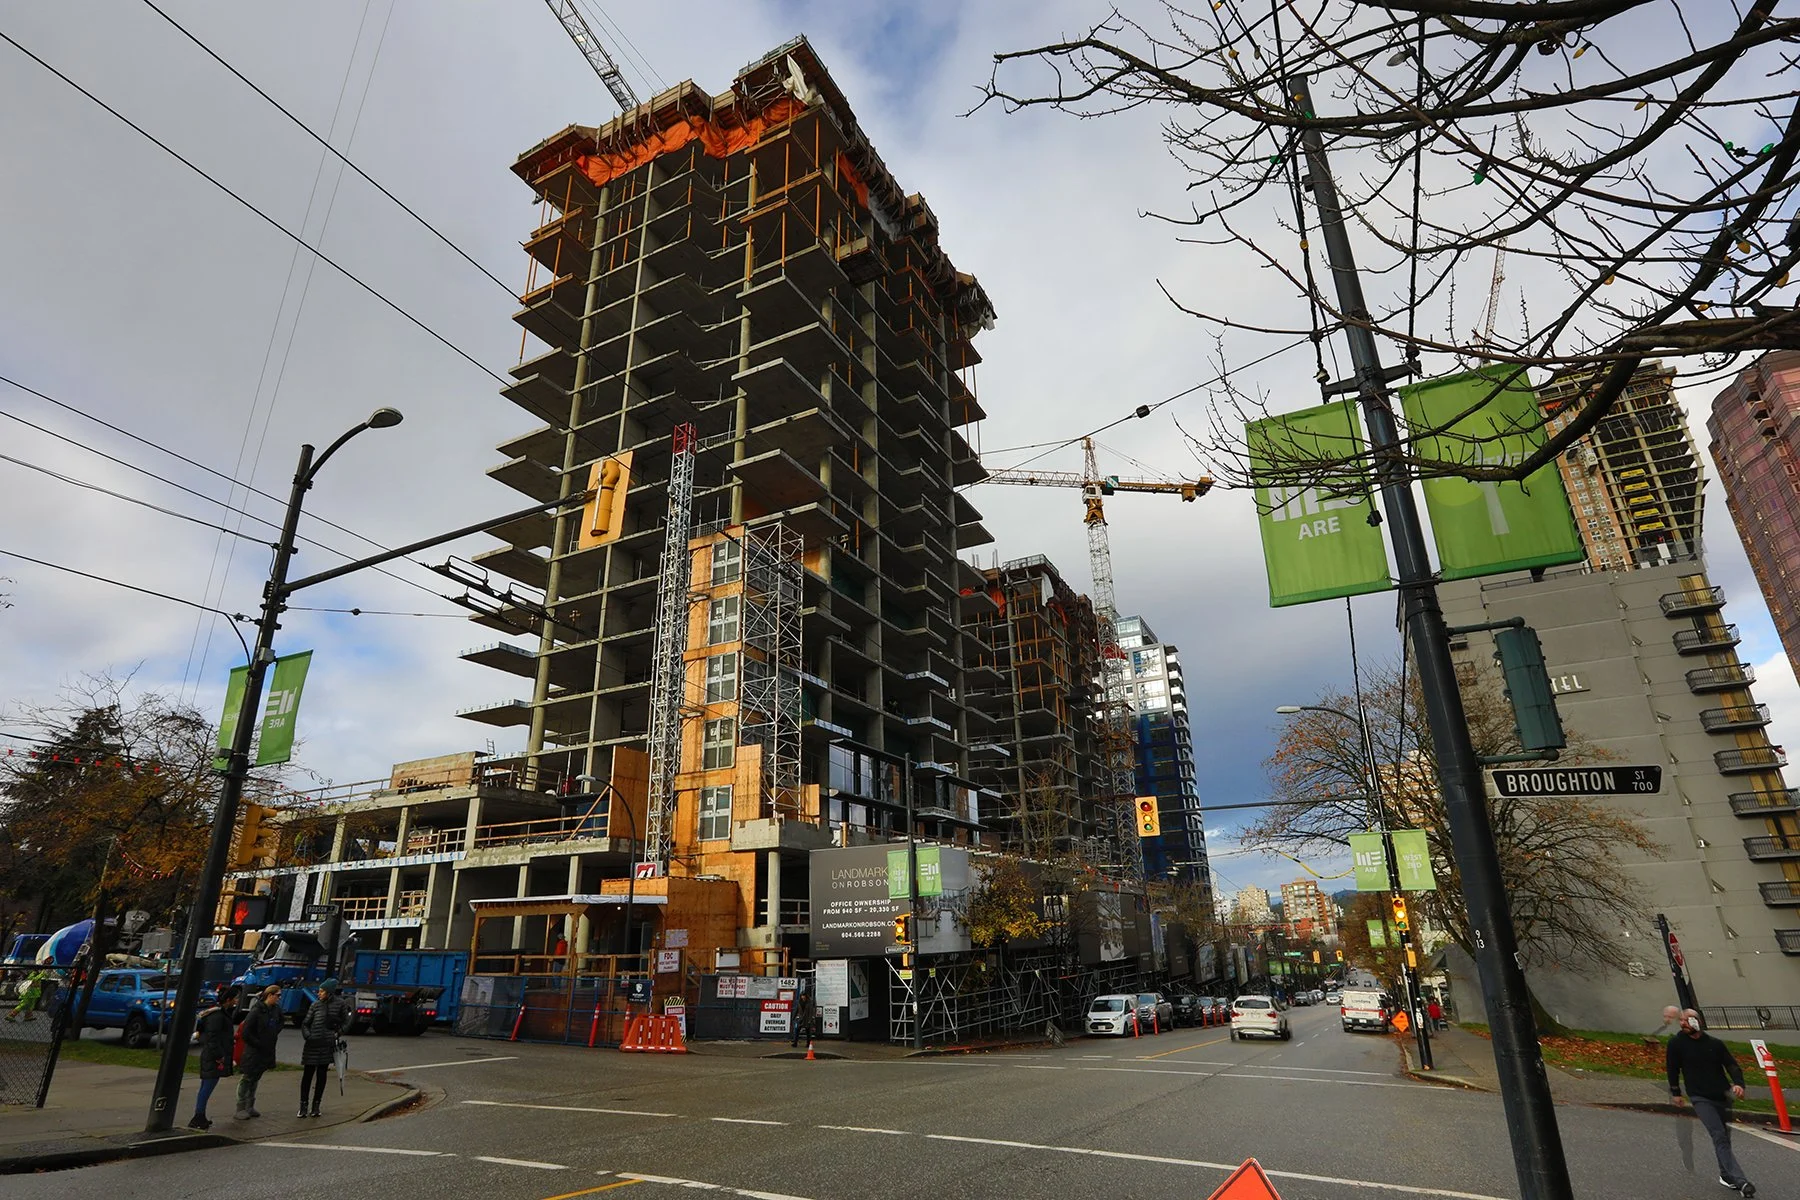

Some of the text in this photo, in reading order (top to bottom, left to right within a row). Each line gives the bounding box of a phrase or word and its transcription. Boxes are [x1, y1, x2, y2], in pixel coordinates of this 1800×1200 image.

[1298, 516, 1341, 541] ARE
[1551, 674, 1583, 693] TEL
[1634, 770, 1645, 780] ST
[1506, 771, 1616, 793] BROUGHTON
[1632, 781, 1653, 791] 700
[1356, 851, 1382, 866] WE
[1403, 853, 1422, 861] WEST
[831, 866, 889, 880] LANDMARK
[854, 899, 891, 907] OWNERSHIP
[822, 920, 896, 929] LANDMARKONROBSON.CO
[1475, 930, 1480, 939] 9
[1476, 939, 1485, 948] 13
